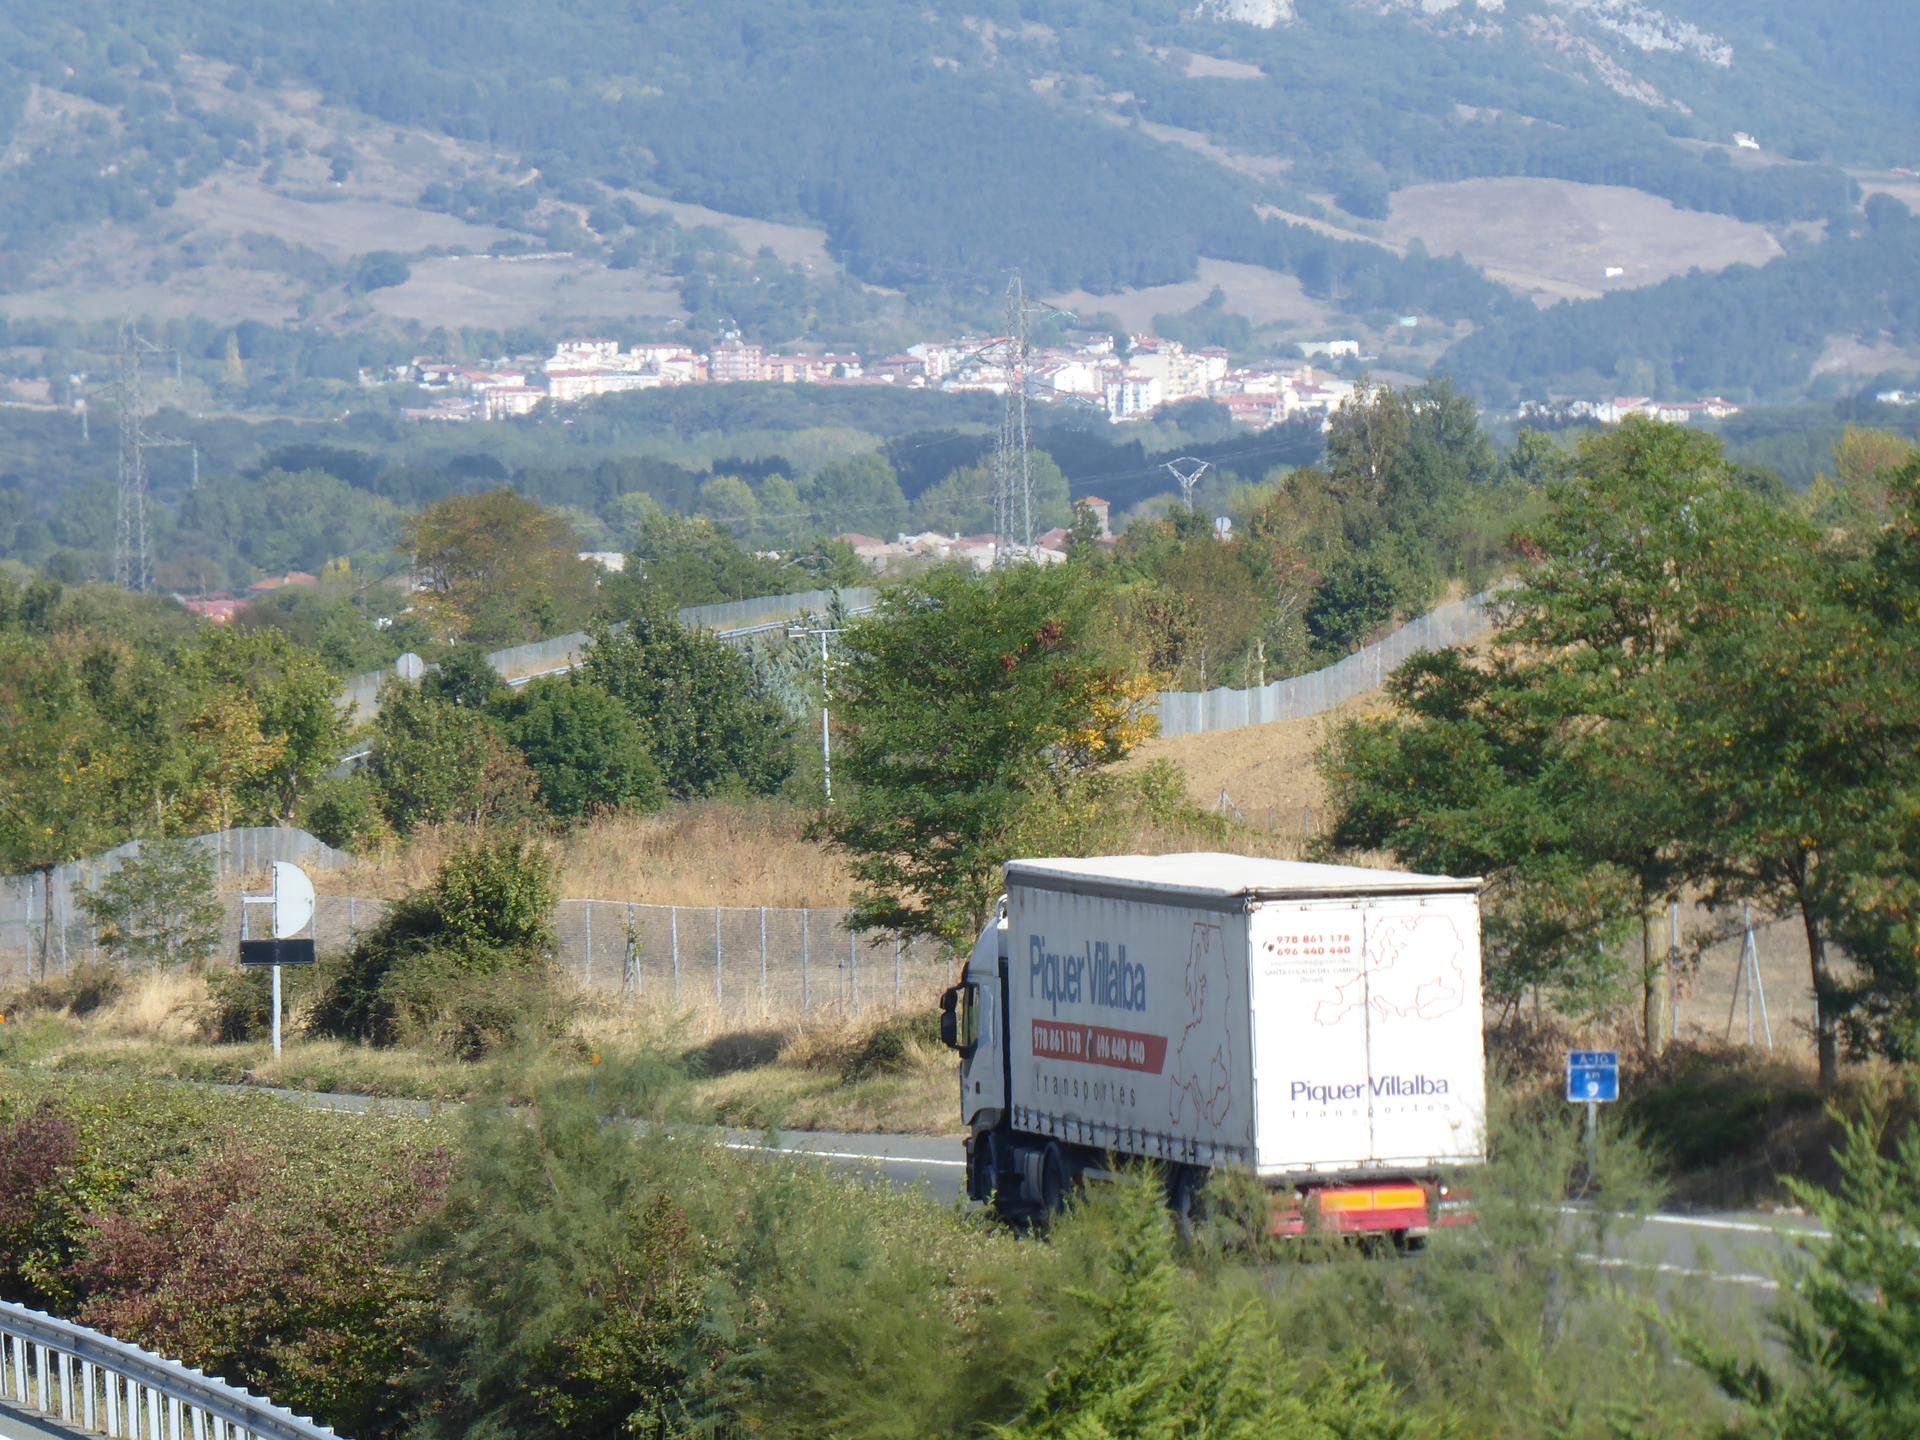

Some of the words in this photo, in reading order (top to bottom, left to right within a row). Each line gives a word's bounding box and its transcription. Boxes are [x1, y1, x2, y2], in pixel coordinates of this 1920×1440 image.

[1276, 936, 1298, 944] 978
[1029, 934, 1085, 1017] Piquer
[1085, 940, 1146, 1012] Villalba
[1035, 1071, 1136, 1107] transportes
[1291, 1080, 1366, 1105] Piquer
[1367, 1074, 1449, 1098] Villalba
[1587, 1081, 1599, 1097] 9
